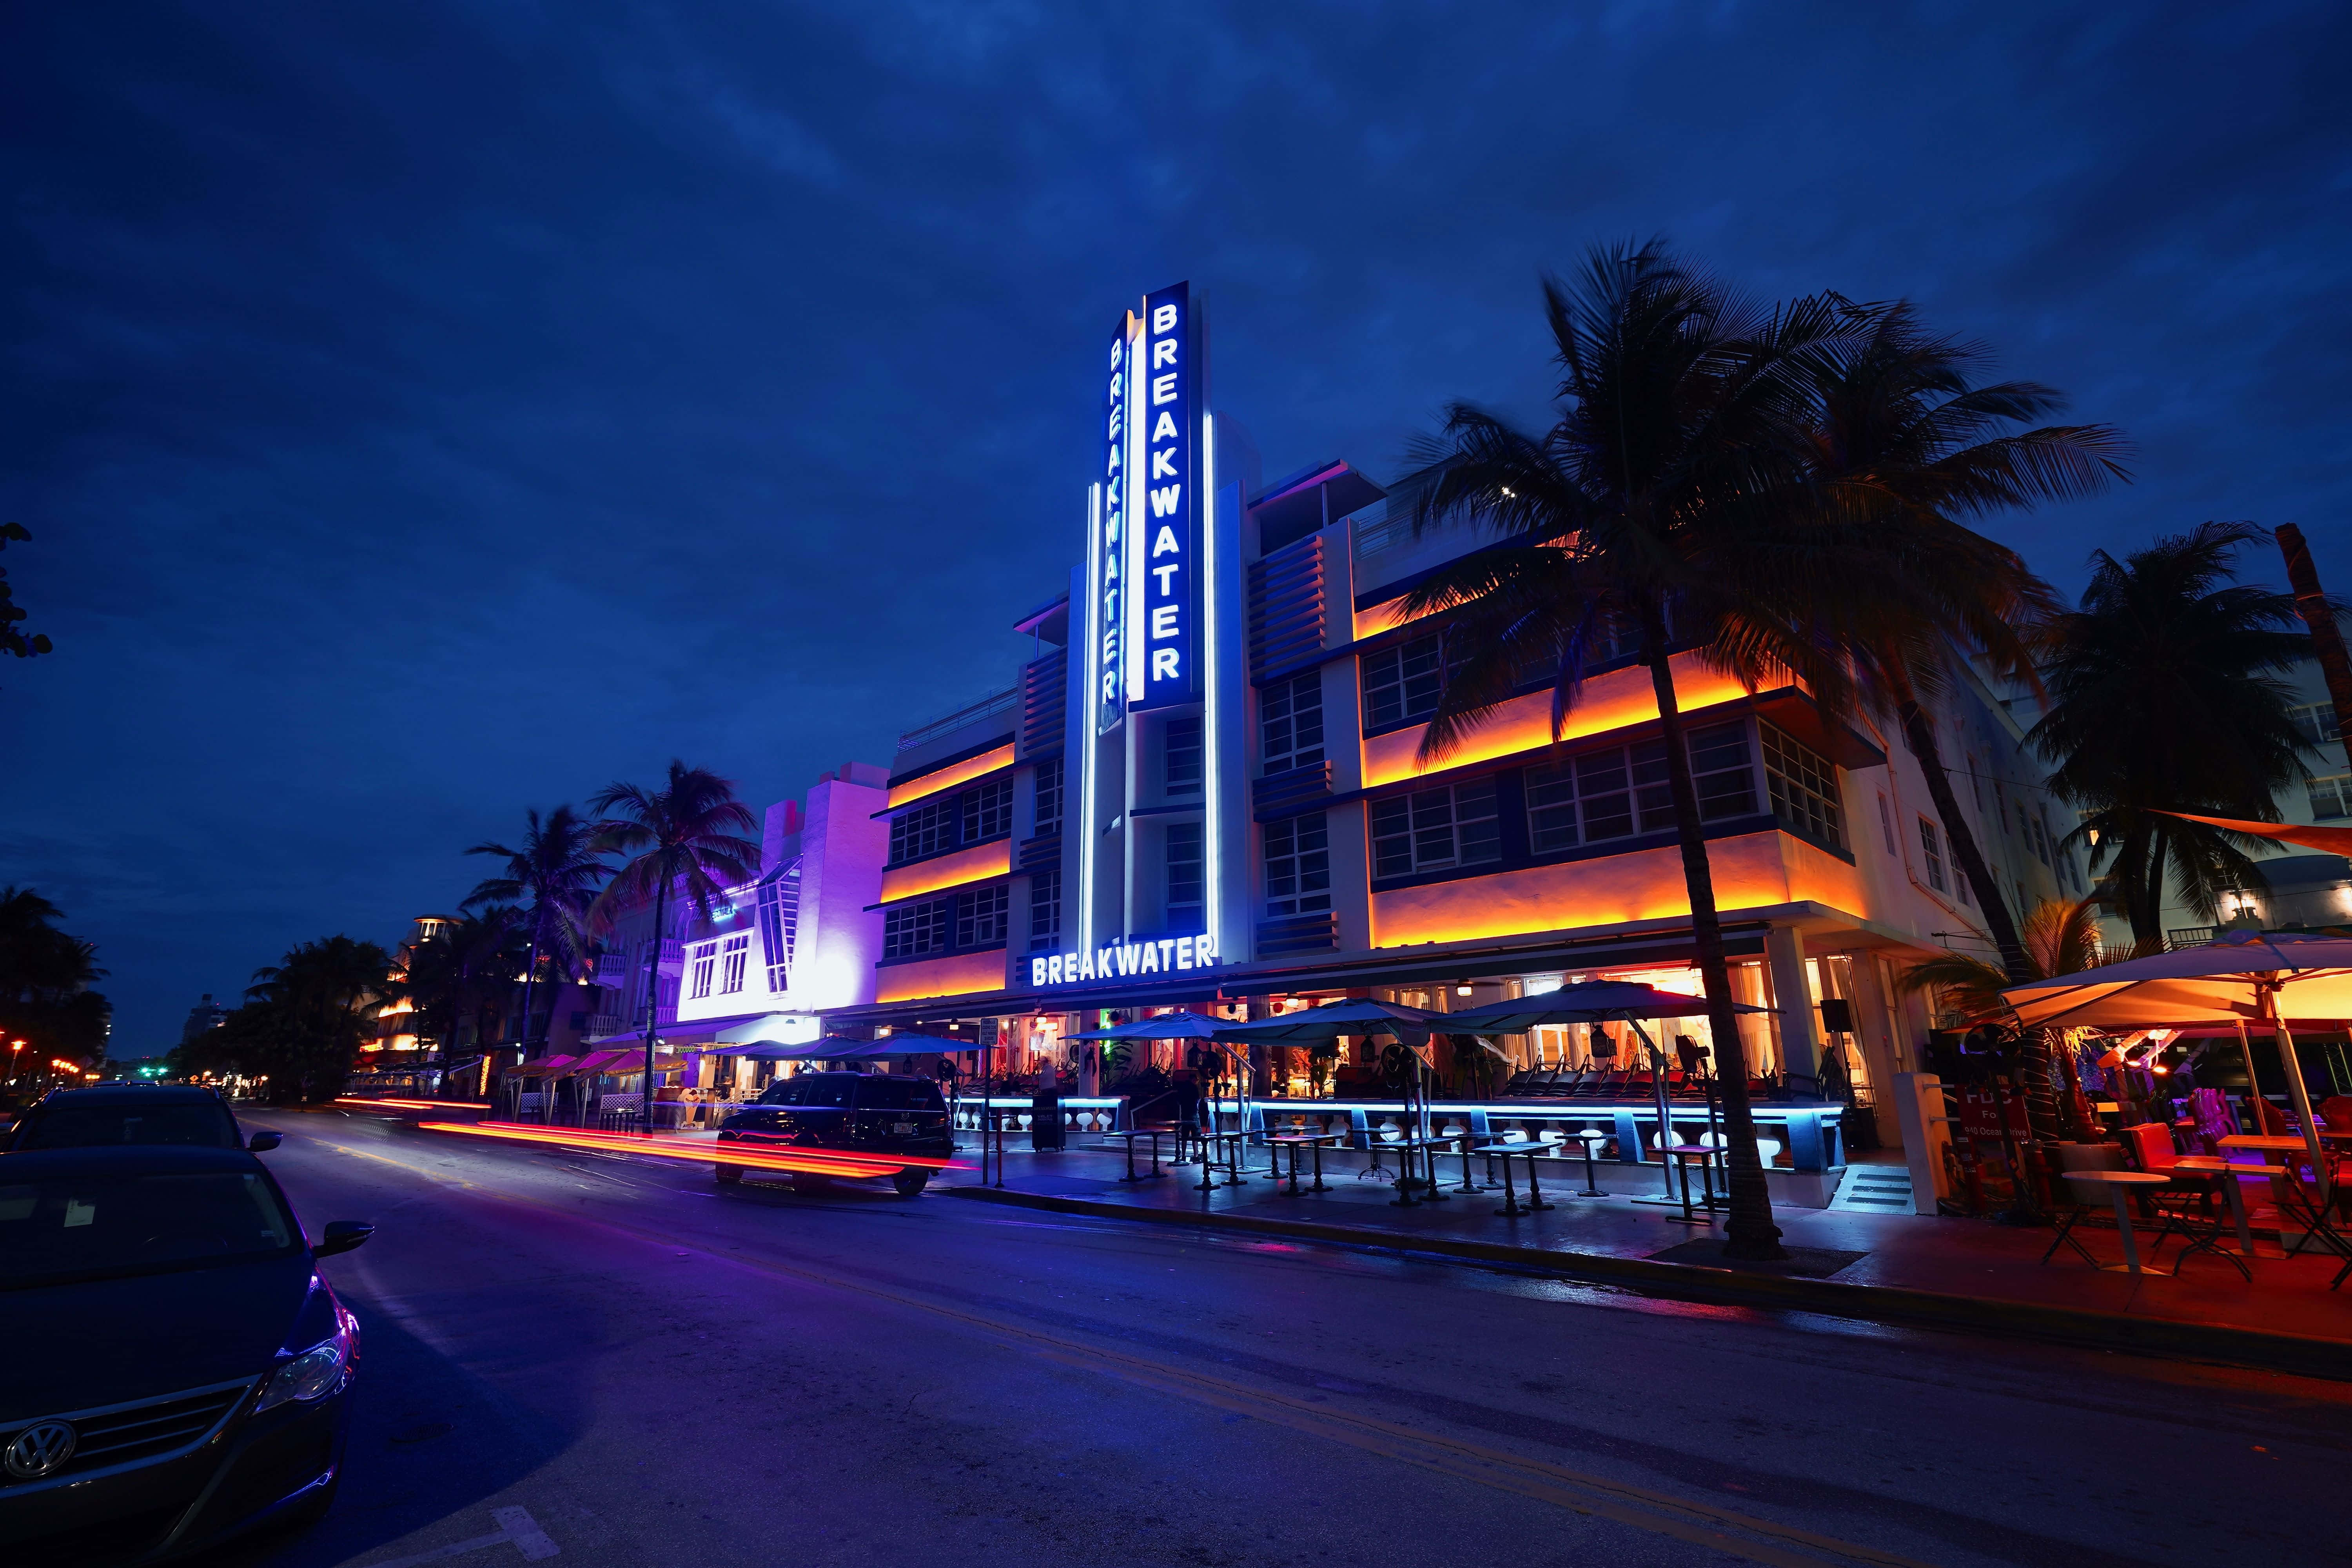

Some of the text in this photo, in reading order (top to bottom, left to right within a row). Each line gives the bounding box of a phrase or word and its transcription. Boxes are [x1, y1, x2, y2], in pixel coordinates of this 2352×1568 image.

[1103, 338, 1123, 704] BREAKWATER
[1151, 304, 1180, 681] BREAKWATER
[1033, 935, 1214, 986] BREAKWATER
